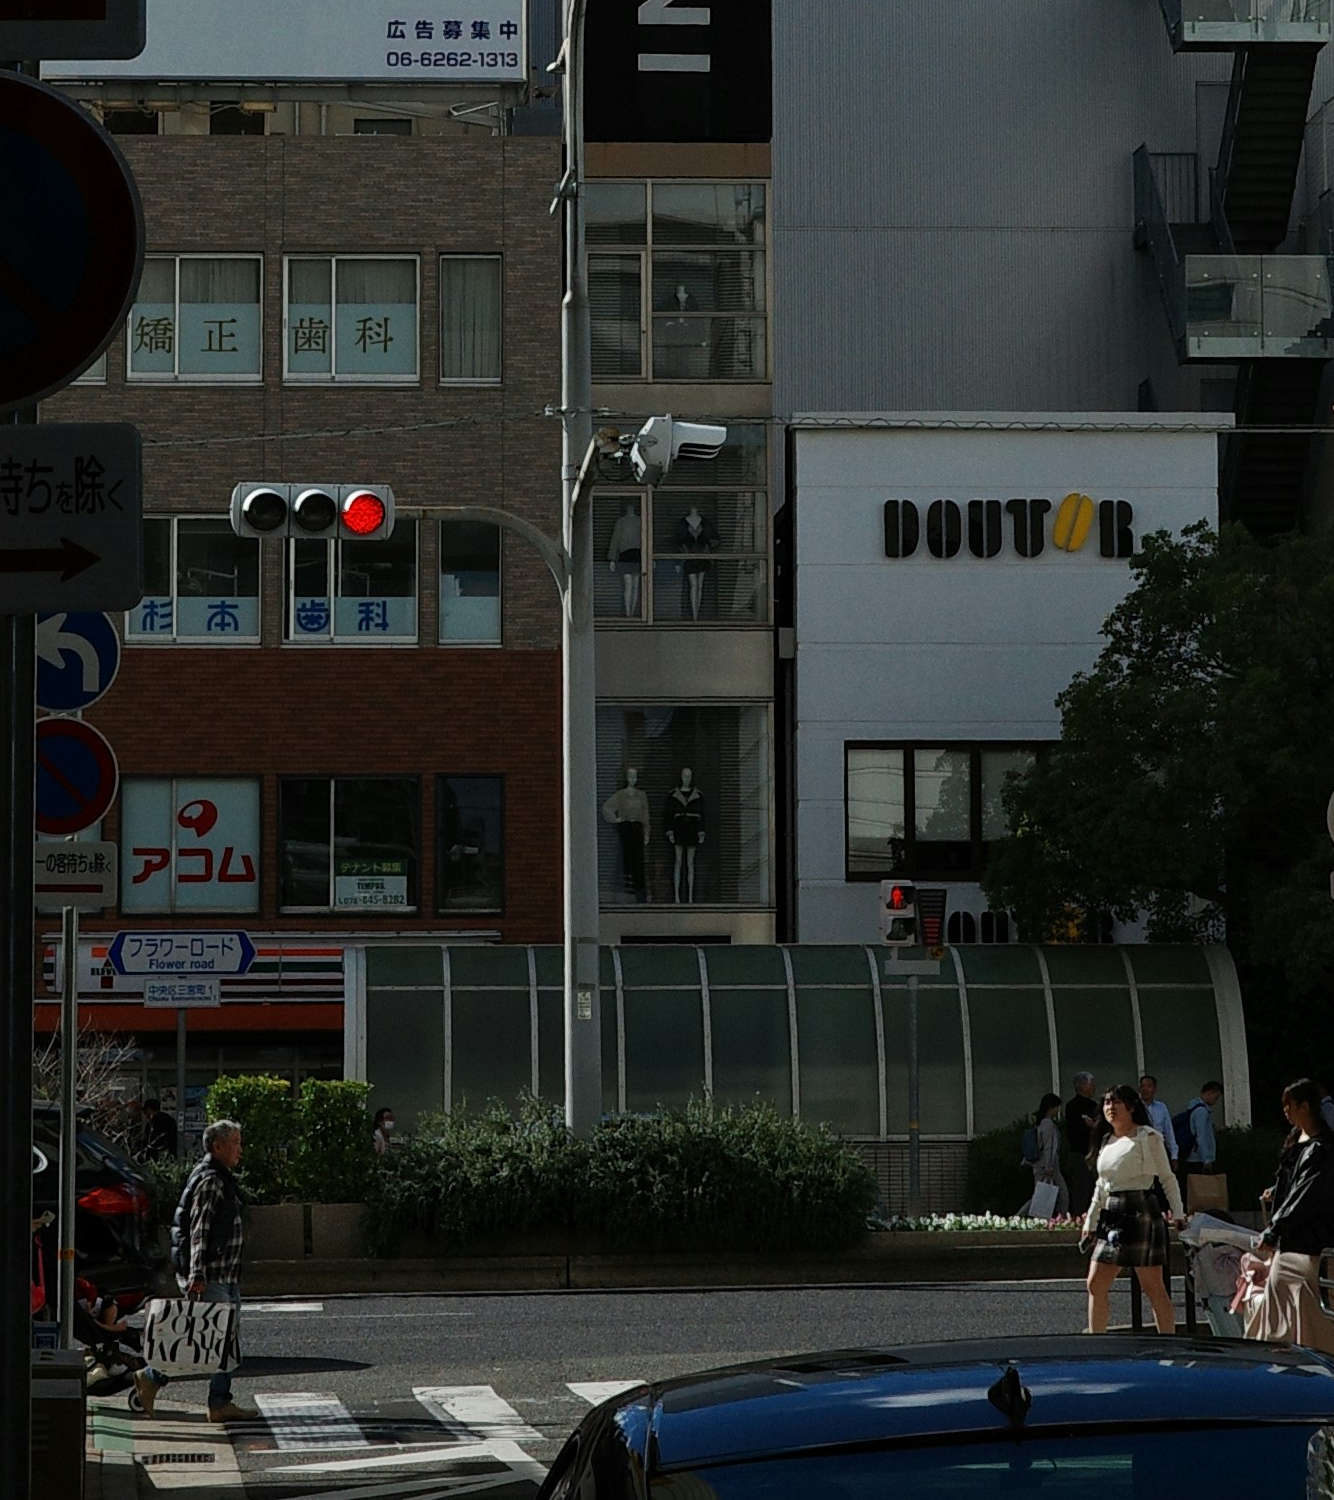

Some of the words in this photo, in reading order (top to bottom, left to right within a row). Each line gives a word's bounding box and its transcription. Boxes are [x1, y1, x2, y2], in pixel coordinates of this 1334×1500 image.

[386, 19, 518, 41] 広告募集中
[386, 51, 518, 68] 06-6262-1313
[883, 493, 1134, 559] DOUTOR
[133, 847, 255, 883] アコム
[129, 936, 235, 957] フラワーロード
[148, 958, 185, 970] Flower
[189, 957, 215, 970] road
